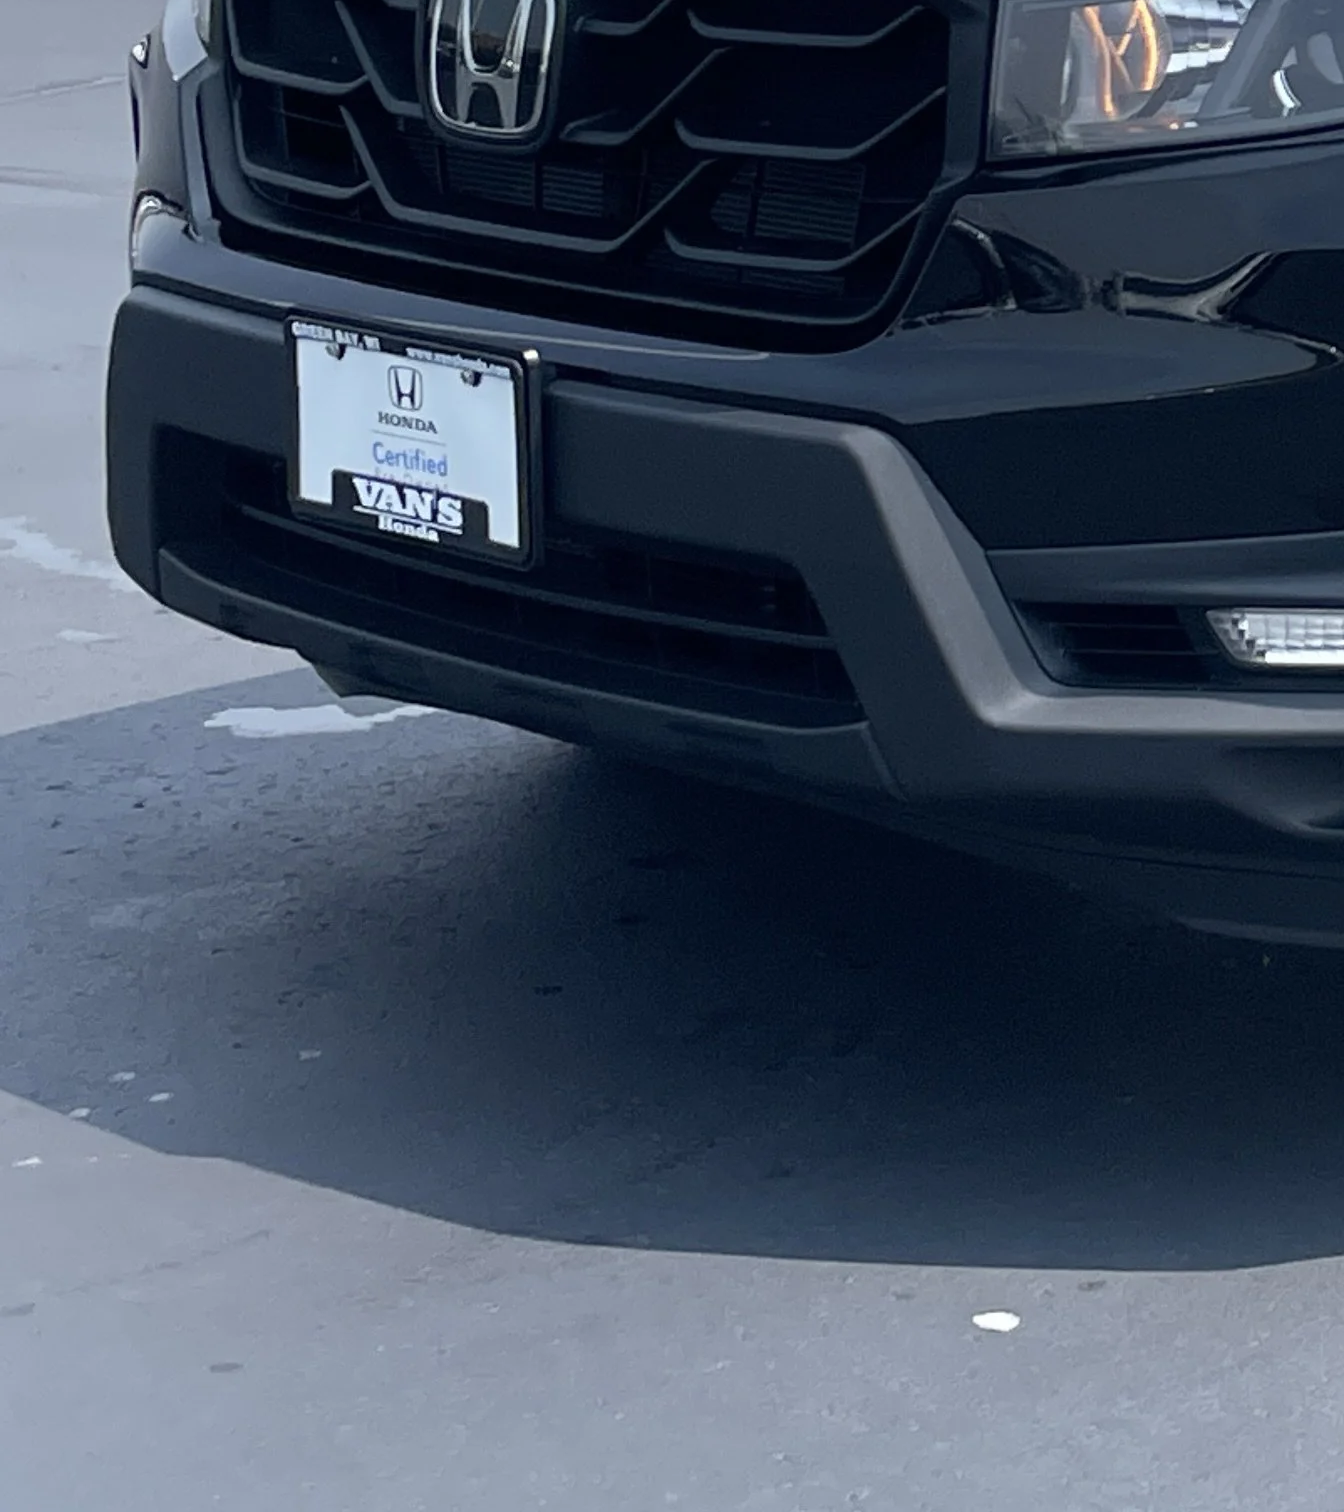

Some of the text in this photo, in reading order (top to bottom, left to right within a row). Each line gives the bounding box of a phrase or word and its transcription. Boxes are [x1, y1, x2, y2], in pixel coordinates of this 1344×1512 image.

[377, 411, 438, 435] HONDA
[372, 441, 448, 477] Certified
[378, 513, 440, 543] Honda
